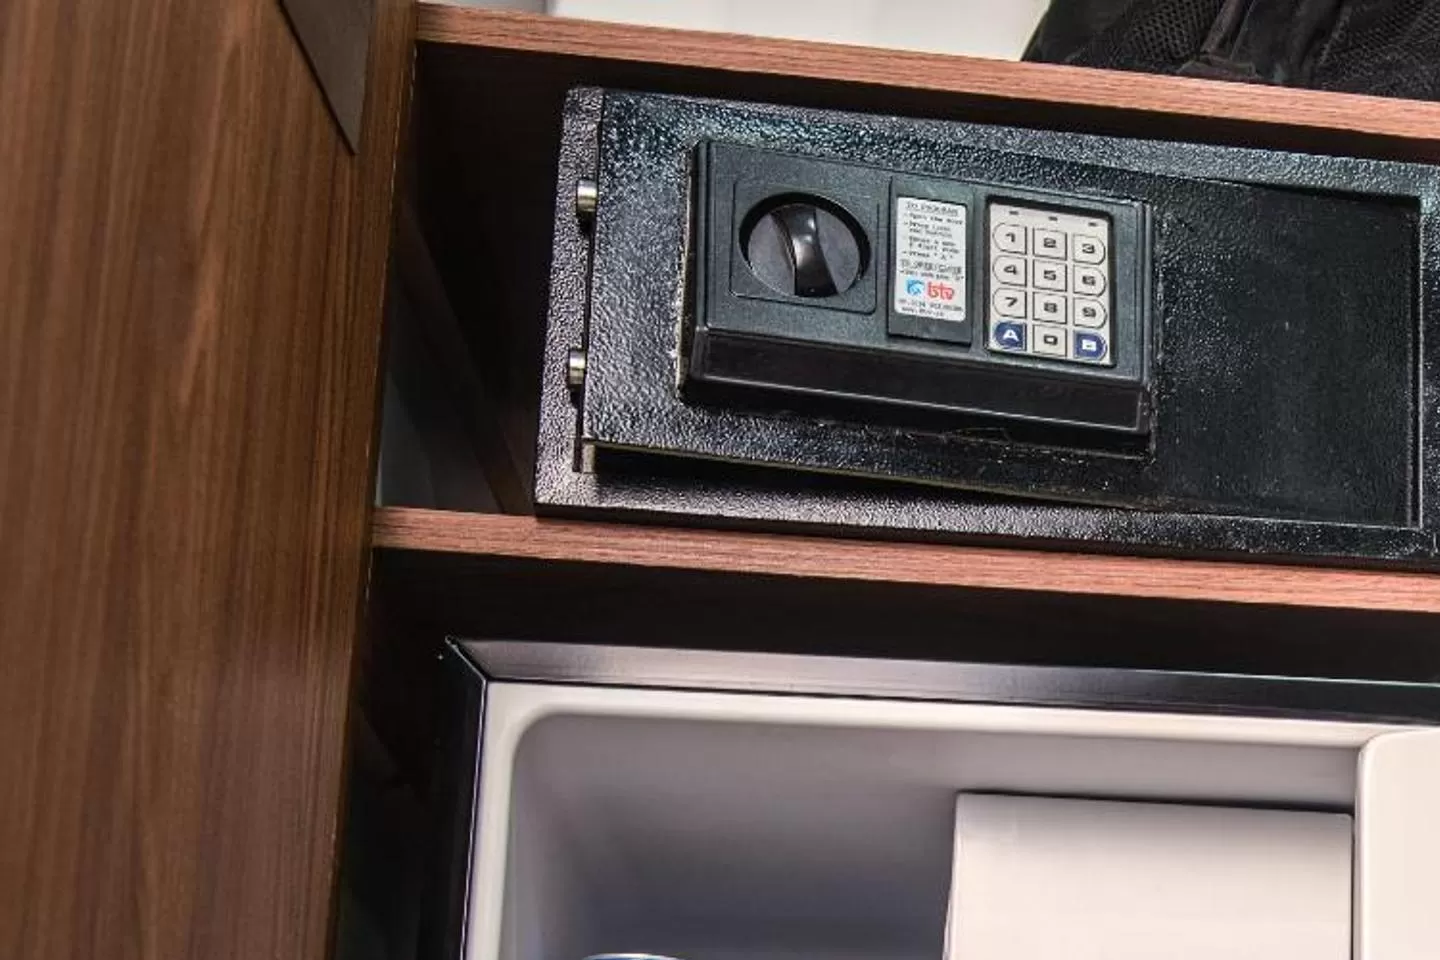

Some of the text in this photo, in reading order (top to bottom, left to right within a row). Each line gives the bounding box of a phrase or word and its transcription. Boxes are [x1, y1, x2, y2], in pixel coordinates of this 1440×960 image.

[1004, 232, 1096, 255] 1 2 3
[1003, 264, 1096, 287] 4 5 6
[1004, 296, 1097, 319] 7 8 9
[1003, 329, 1019, 342] A
